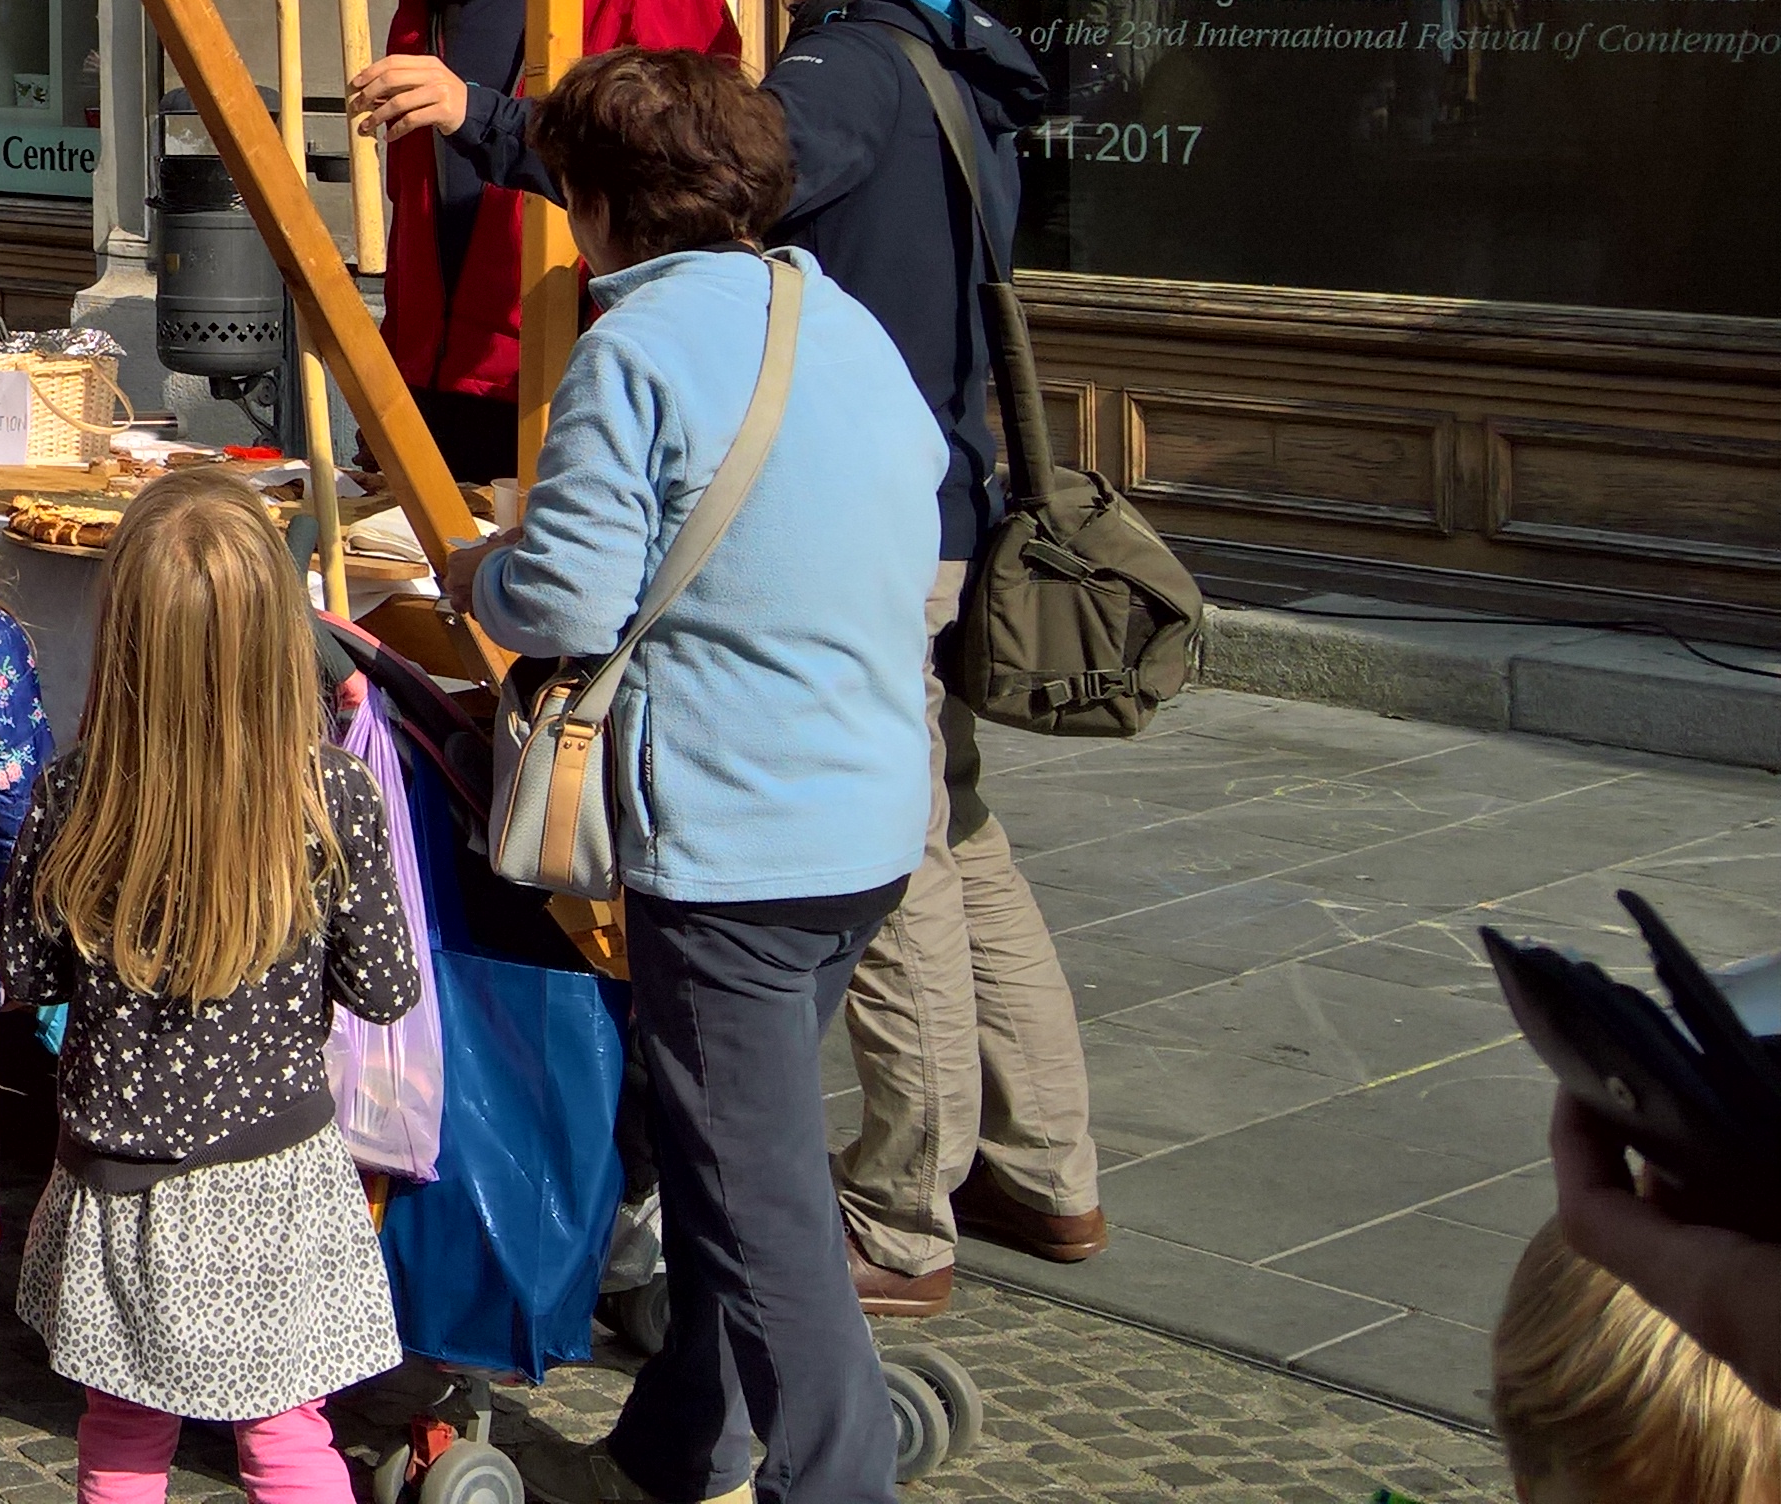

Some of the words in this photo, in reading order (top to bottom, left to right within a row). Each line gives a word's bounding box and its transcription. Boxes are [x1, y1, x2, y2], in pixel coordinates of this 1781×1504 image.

[1030, 18, 1062, 52] of
[1064, 20, 1108, 45] the
[1116, 18, 1189, 50] 23rd
[1194, 21, 1410, 51] International
[1415, 22, 1545, 52] Festival
[1553, 23, 1594, 60] of
[1599, 24, 1781, 63] Contempo
[3, 135, 96, 174] Centre
[1017, 120, 1204, 166] .11.2017
